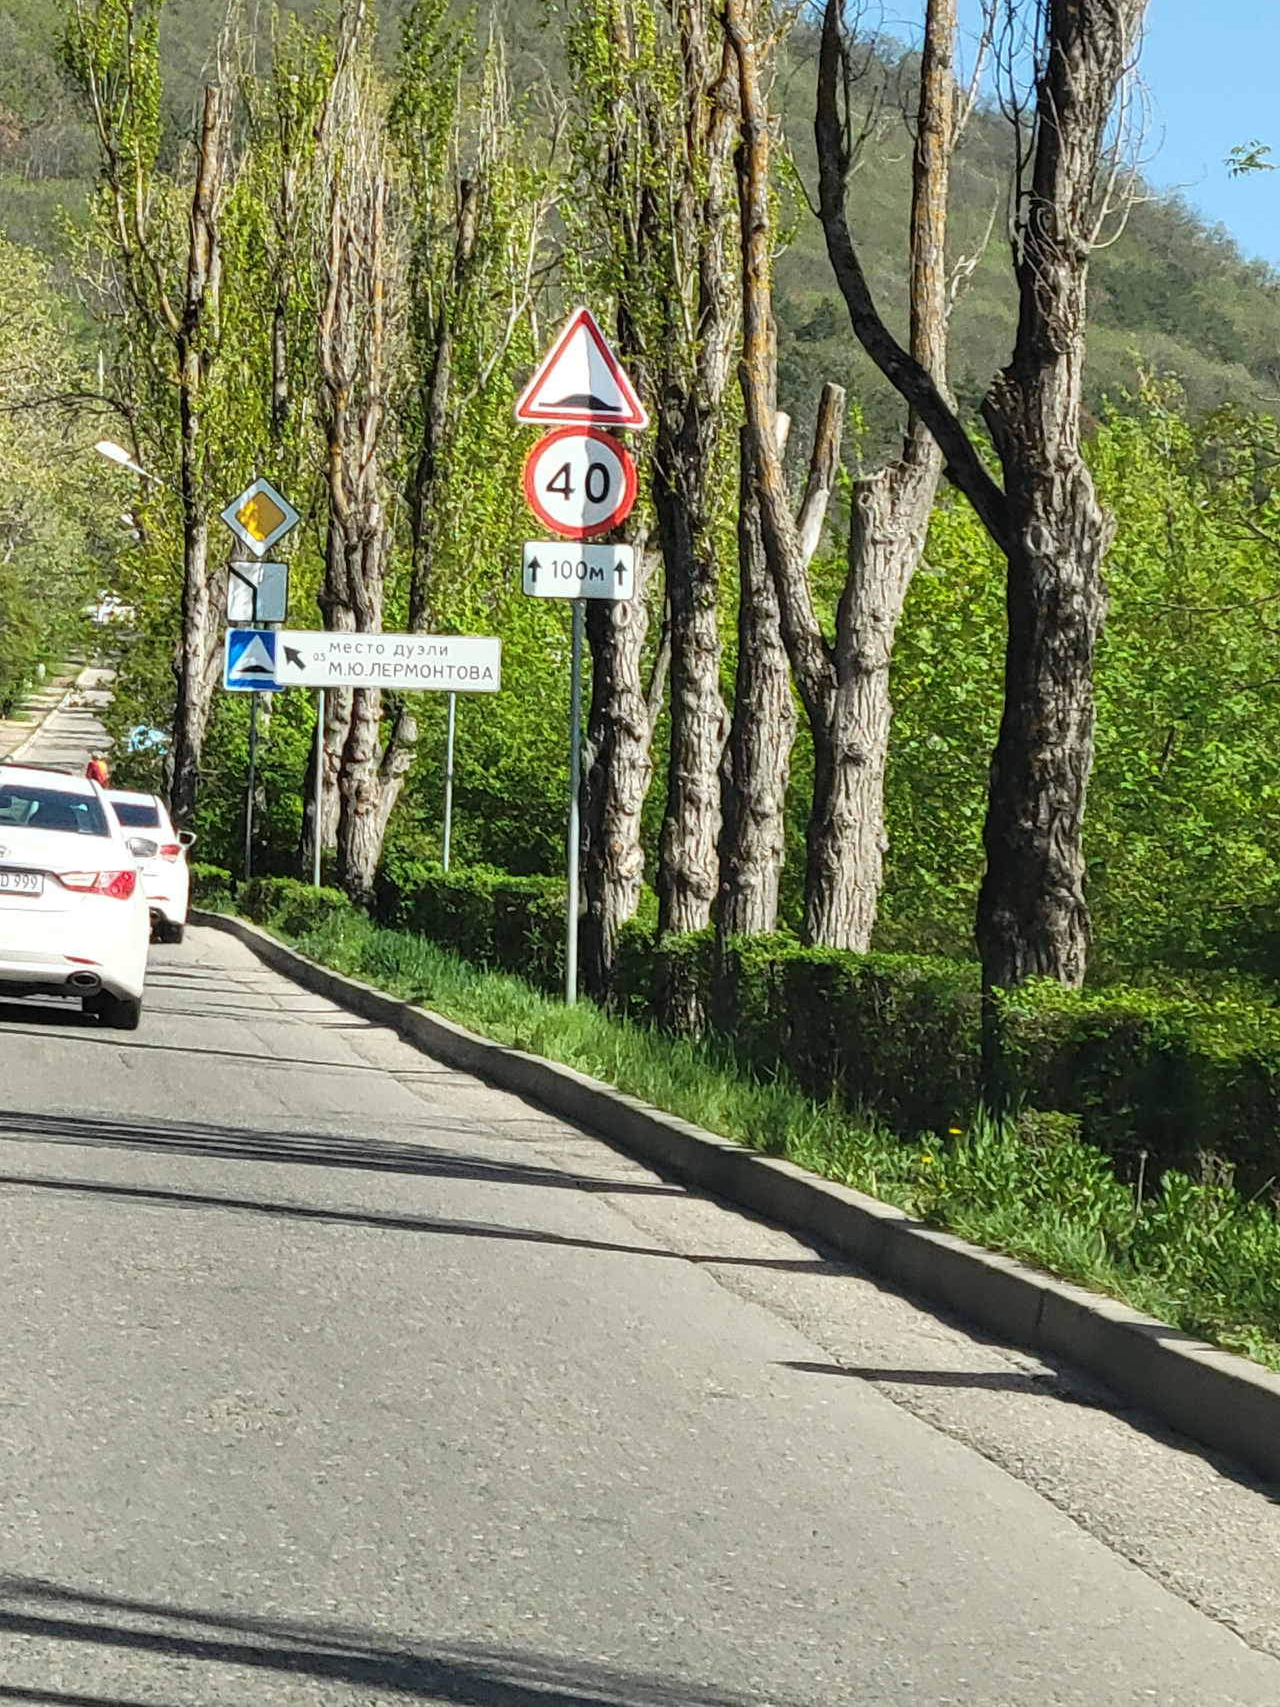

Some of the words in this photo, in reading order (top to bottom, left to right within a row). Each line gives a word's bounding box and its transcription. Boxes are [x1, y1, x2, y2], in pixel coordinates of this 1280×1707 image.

[546, 461, 610, 504] 40
[329, 642, 385, 655] место
[393, 644, 449, 659] дуэли
[328, 661, 494, 681] М.Ю.ЛЕРМОНТОВА
[14, 874, 38, 890] 999
